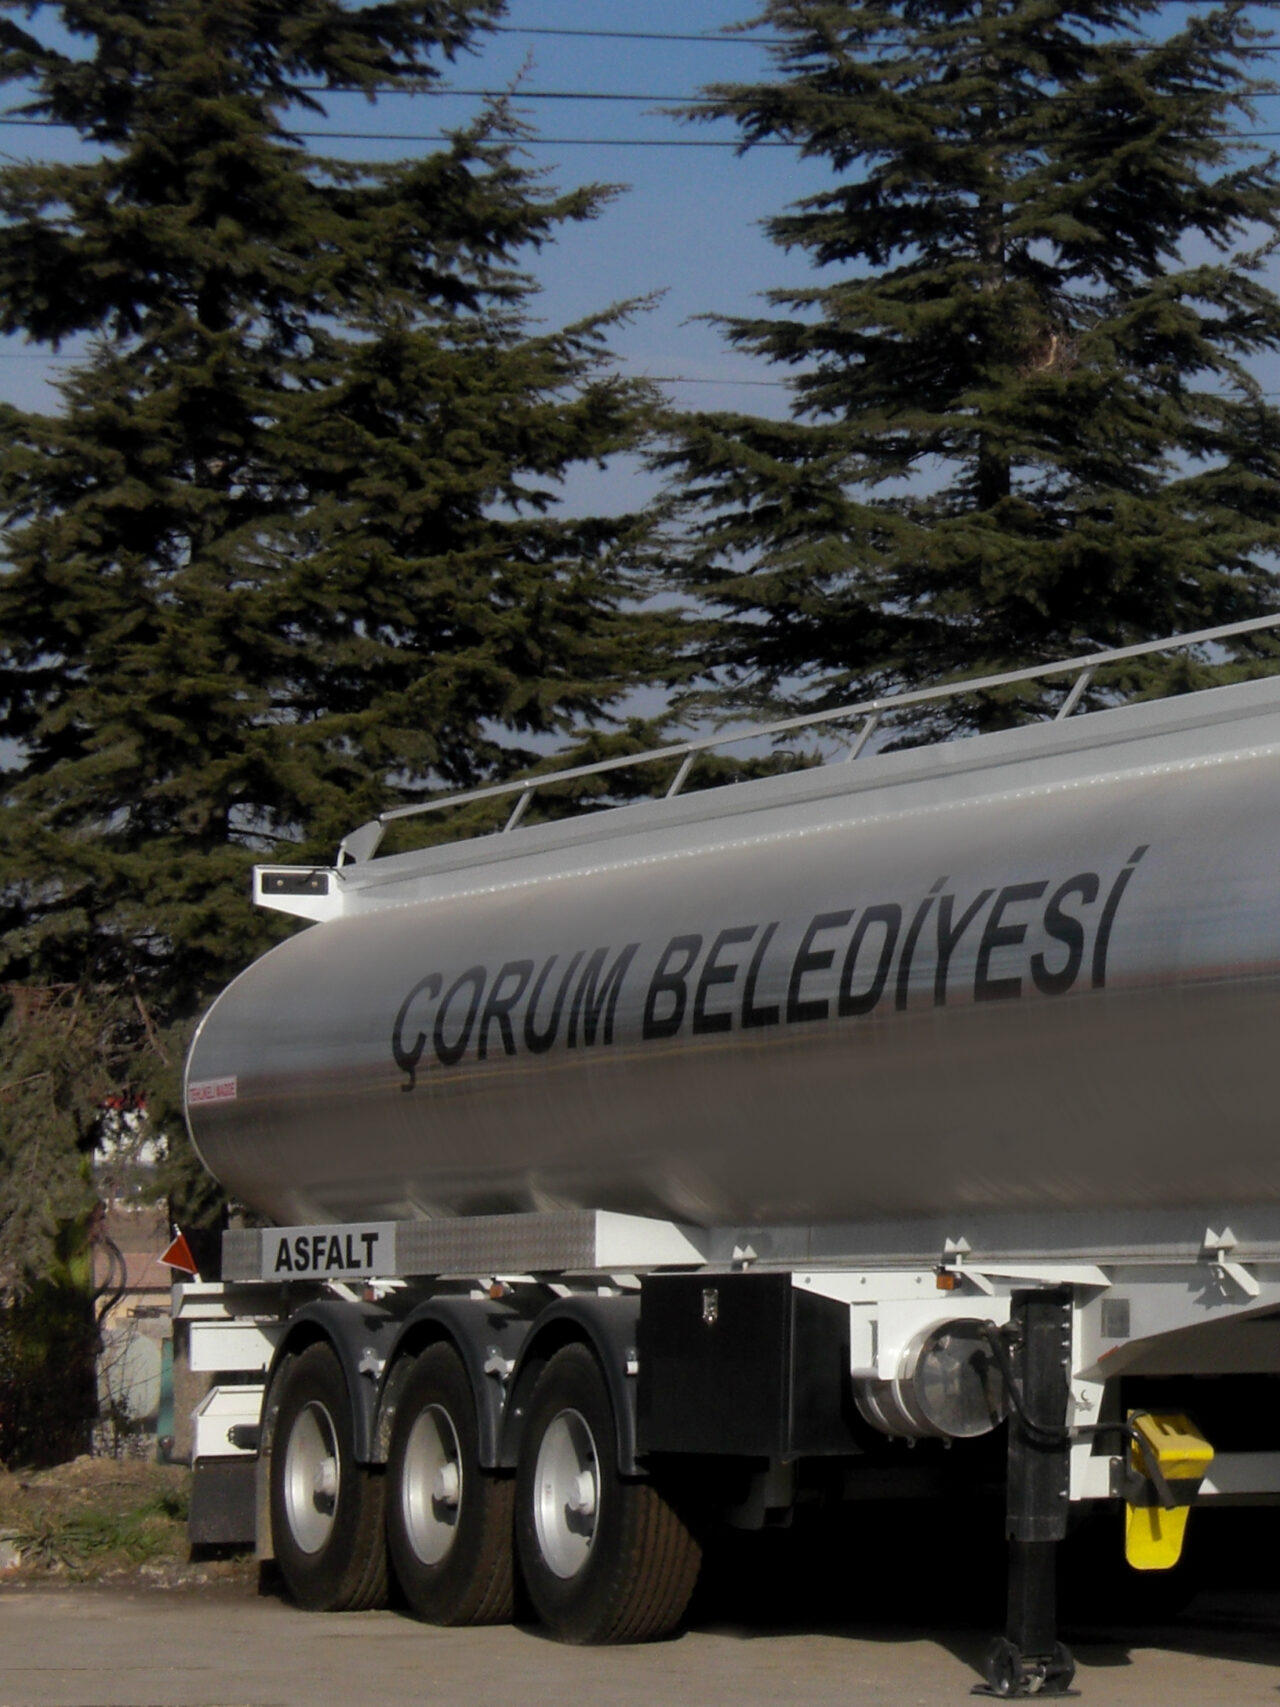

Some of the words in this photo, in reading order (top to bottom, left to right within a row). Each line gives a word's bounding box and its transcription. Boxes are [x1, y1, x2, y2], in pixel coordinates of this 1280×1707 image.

[391, 942, 641, 1093] ÇORUM
[642, 844, 1150, 1041] BELEDİYESİ
[274, 1232, 379, 1273] ASFALT
